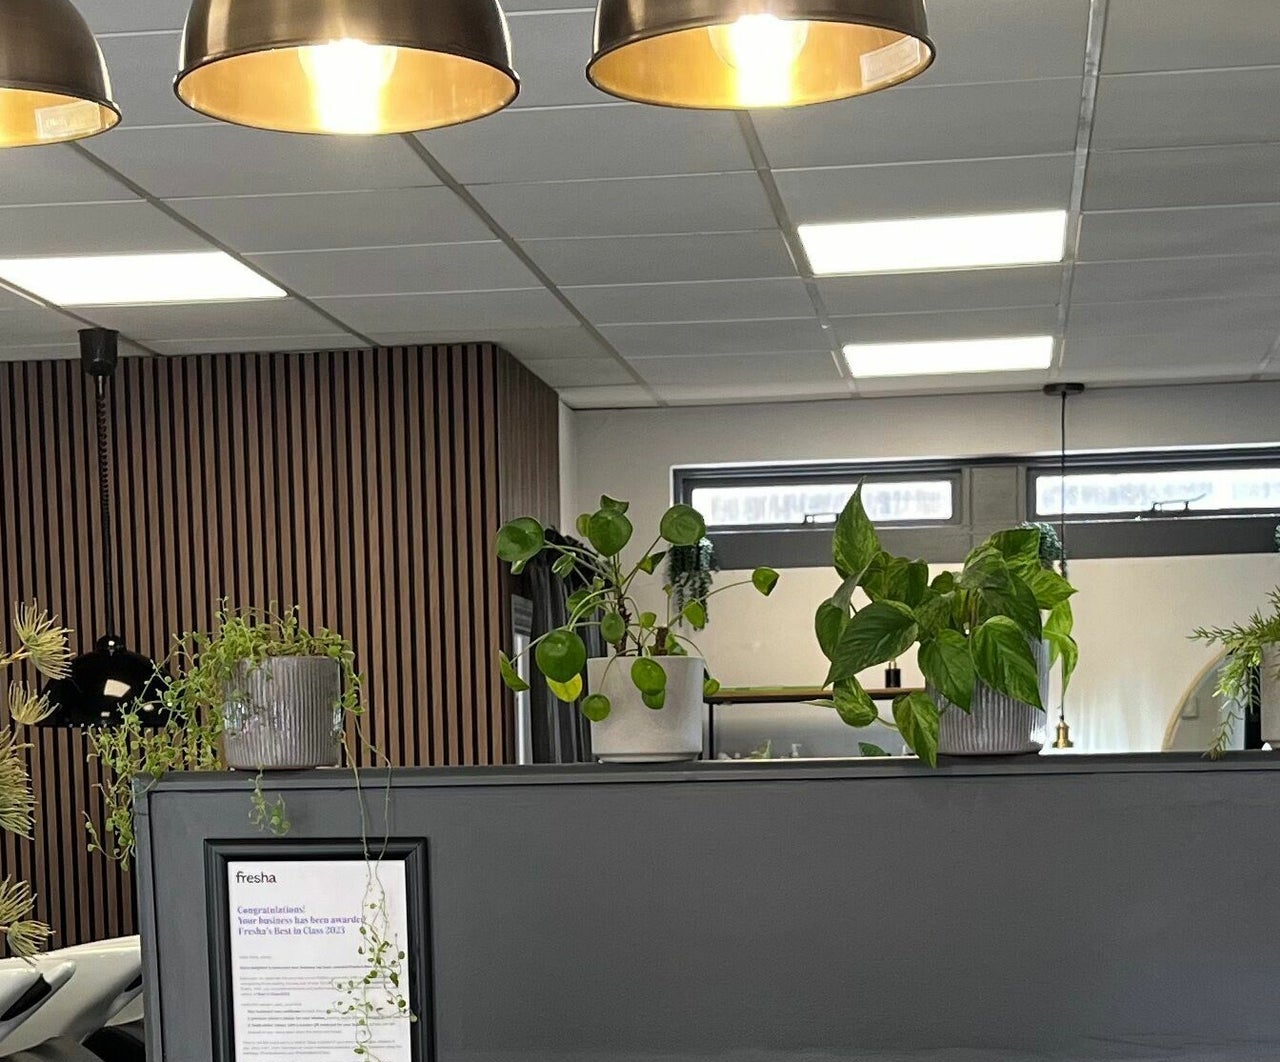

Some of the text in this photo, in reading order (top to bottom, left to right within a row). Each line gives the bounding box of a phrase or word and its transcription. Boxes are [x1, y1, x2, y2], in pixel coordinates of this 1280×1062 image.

[236, 871, 277, 884] fresha
[237, 905, 305, 916] Congratulations!
[258, 916, 293, 924] business
[294, 916, 308, 924] has
[310, 915, 329, 923] been
[238, 926, 345, 936] Fresha's Best in Class 2023
